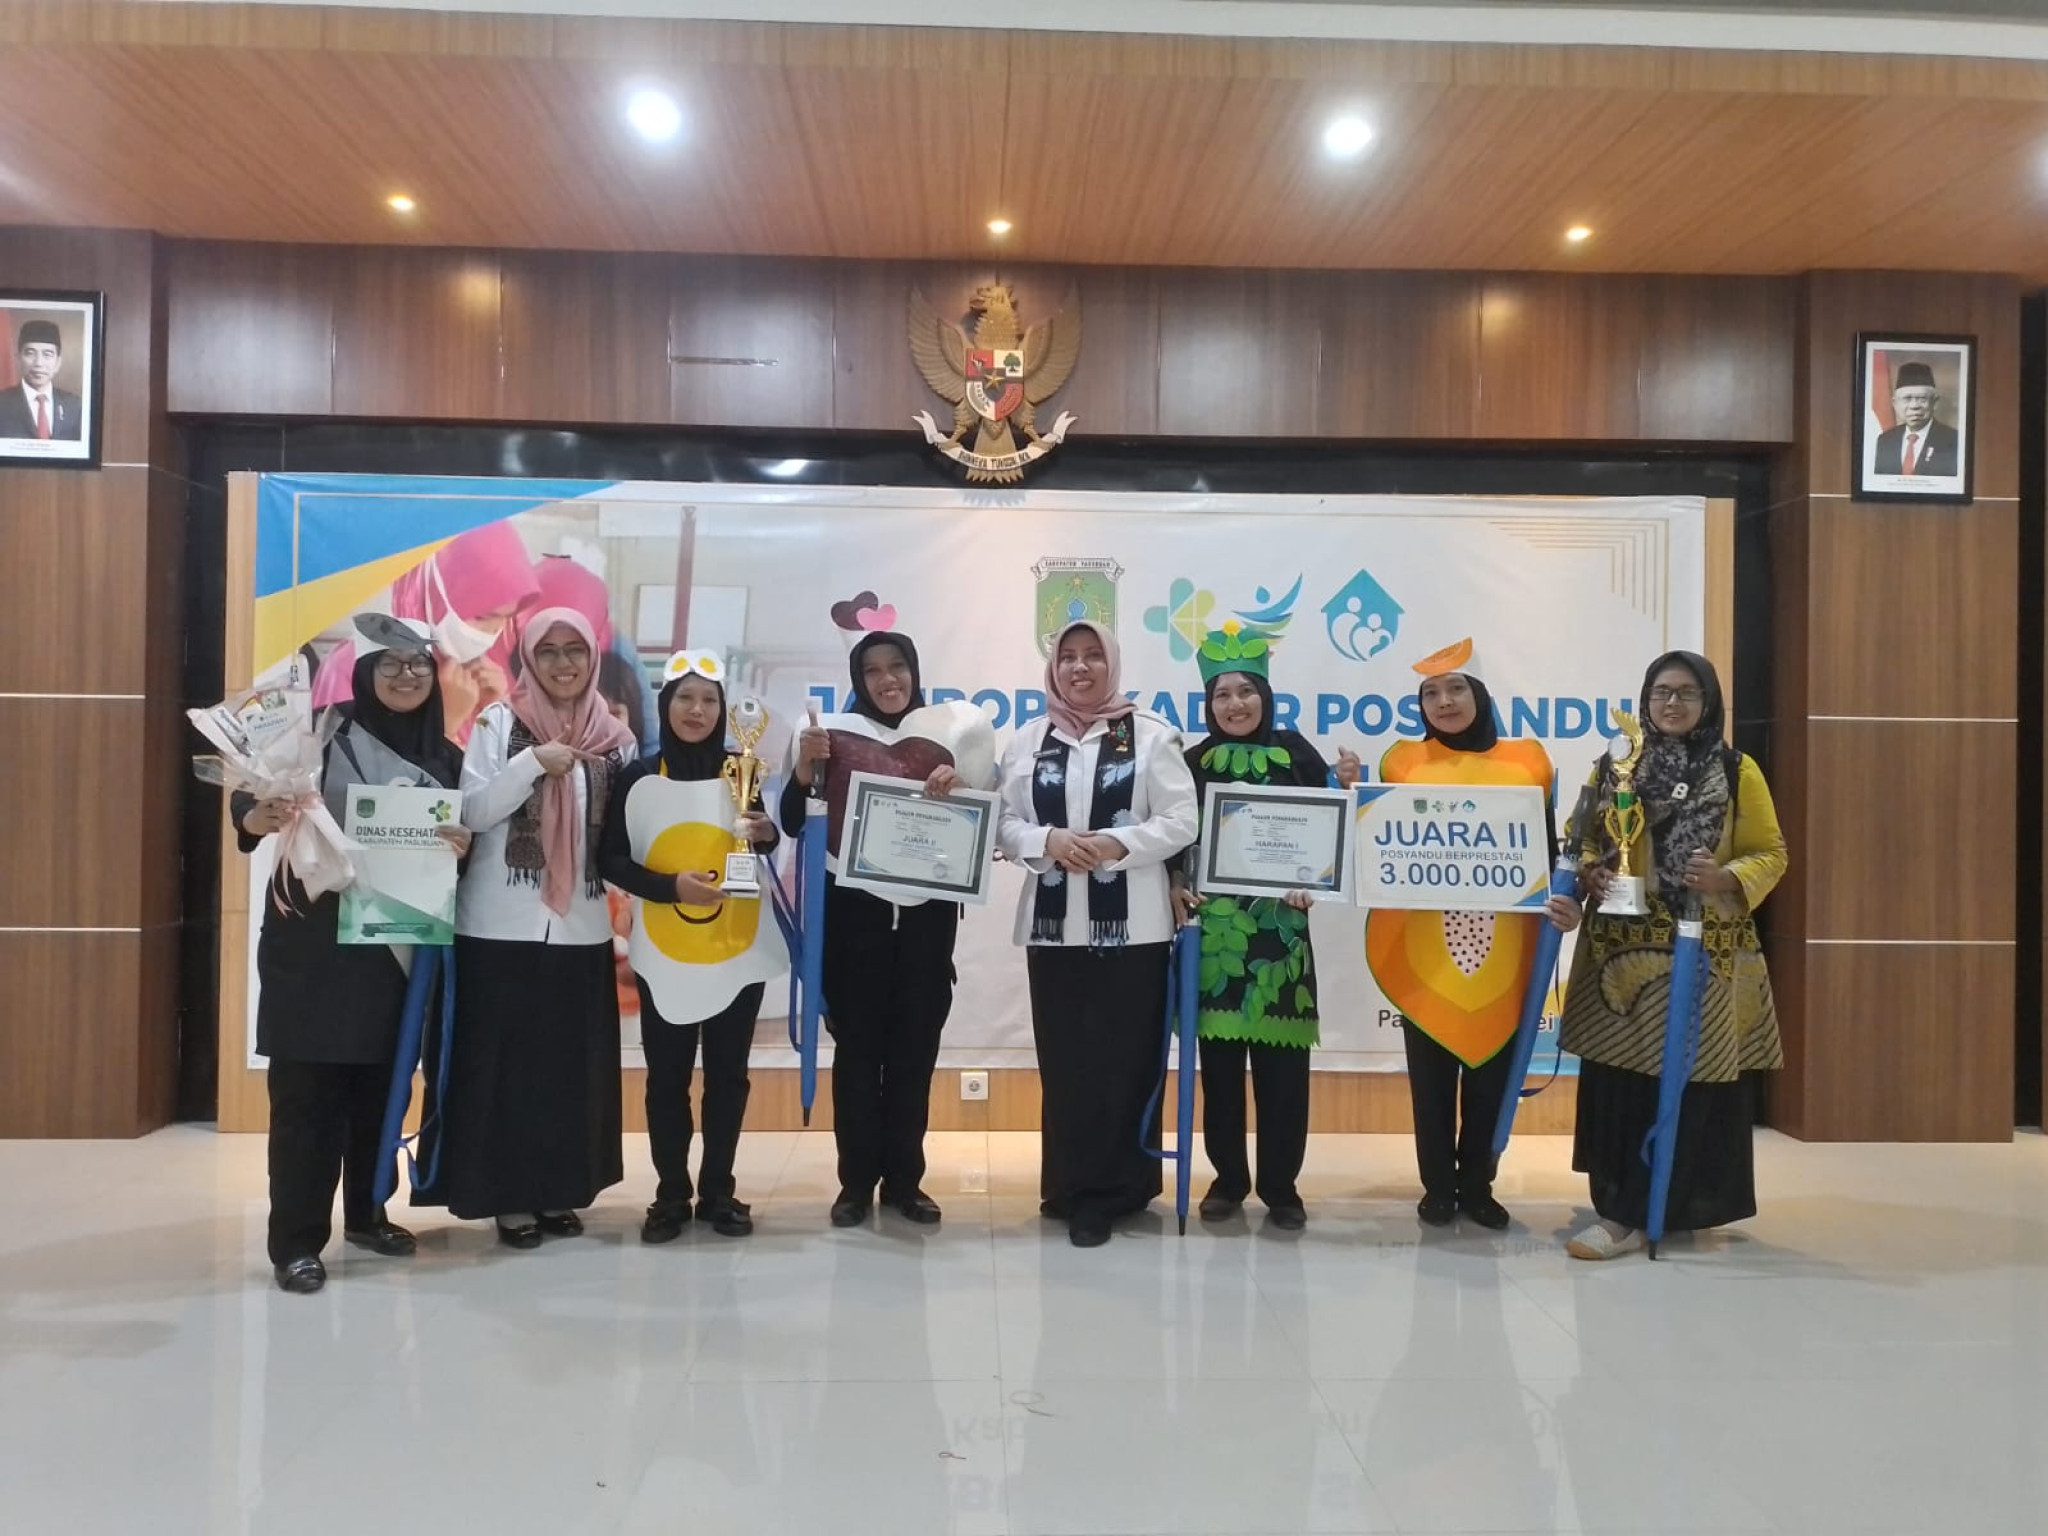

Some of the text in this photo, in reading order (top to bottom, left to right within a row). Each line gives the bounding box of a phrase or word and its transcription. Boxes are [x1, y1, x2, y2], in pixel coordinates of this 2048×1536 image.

[1317, 693, 1632, 739] POSNDU
[356, 826, 441, 838] DINAS KESEHATA
[1375, 820, 1528, 849] JUARA II
[1380, 850, 1523, 862] POSYANDU BERPRESTASI
[1380, 862, 1527, 888] 3.000.000
